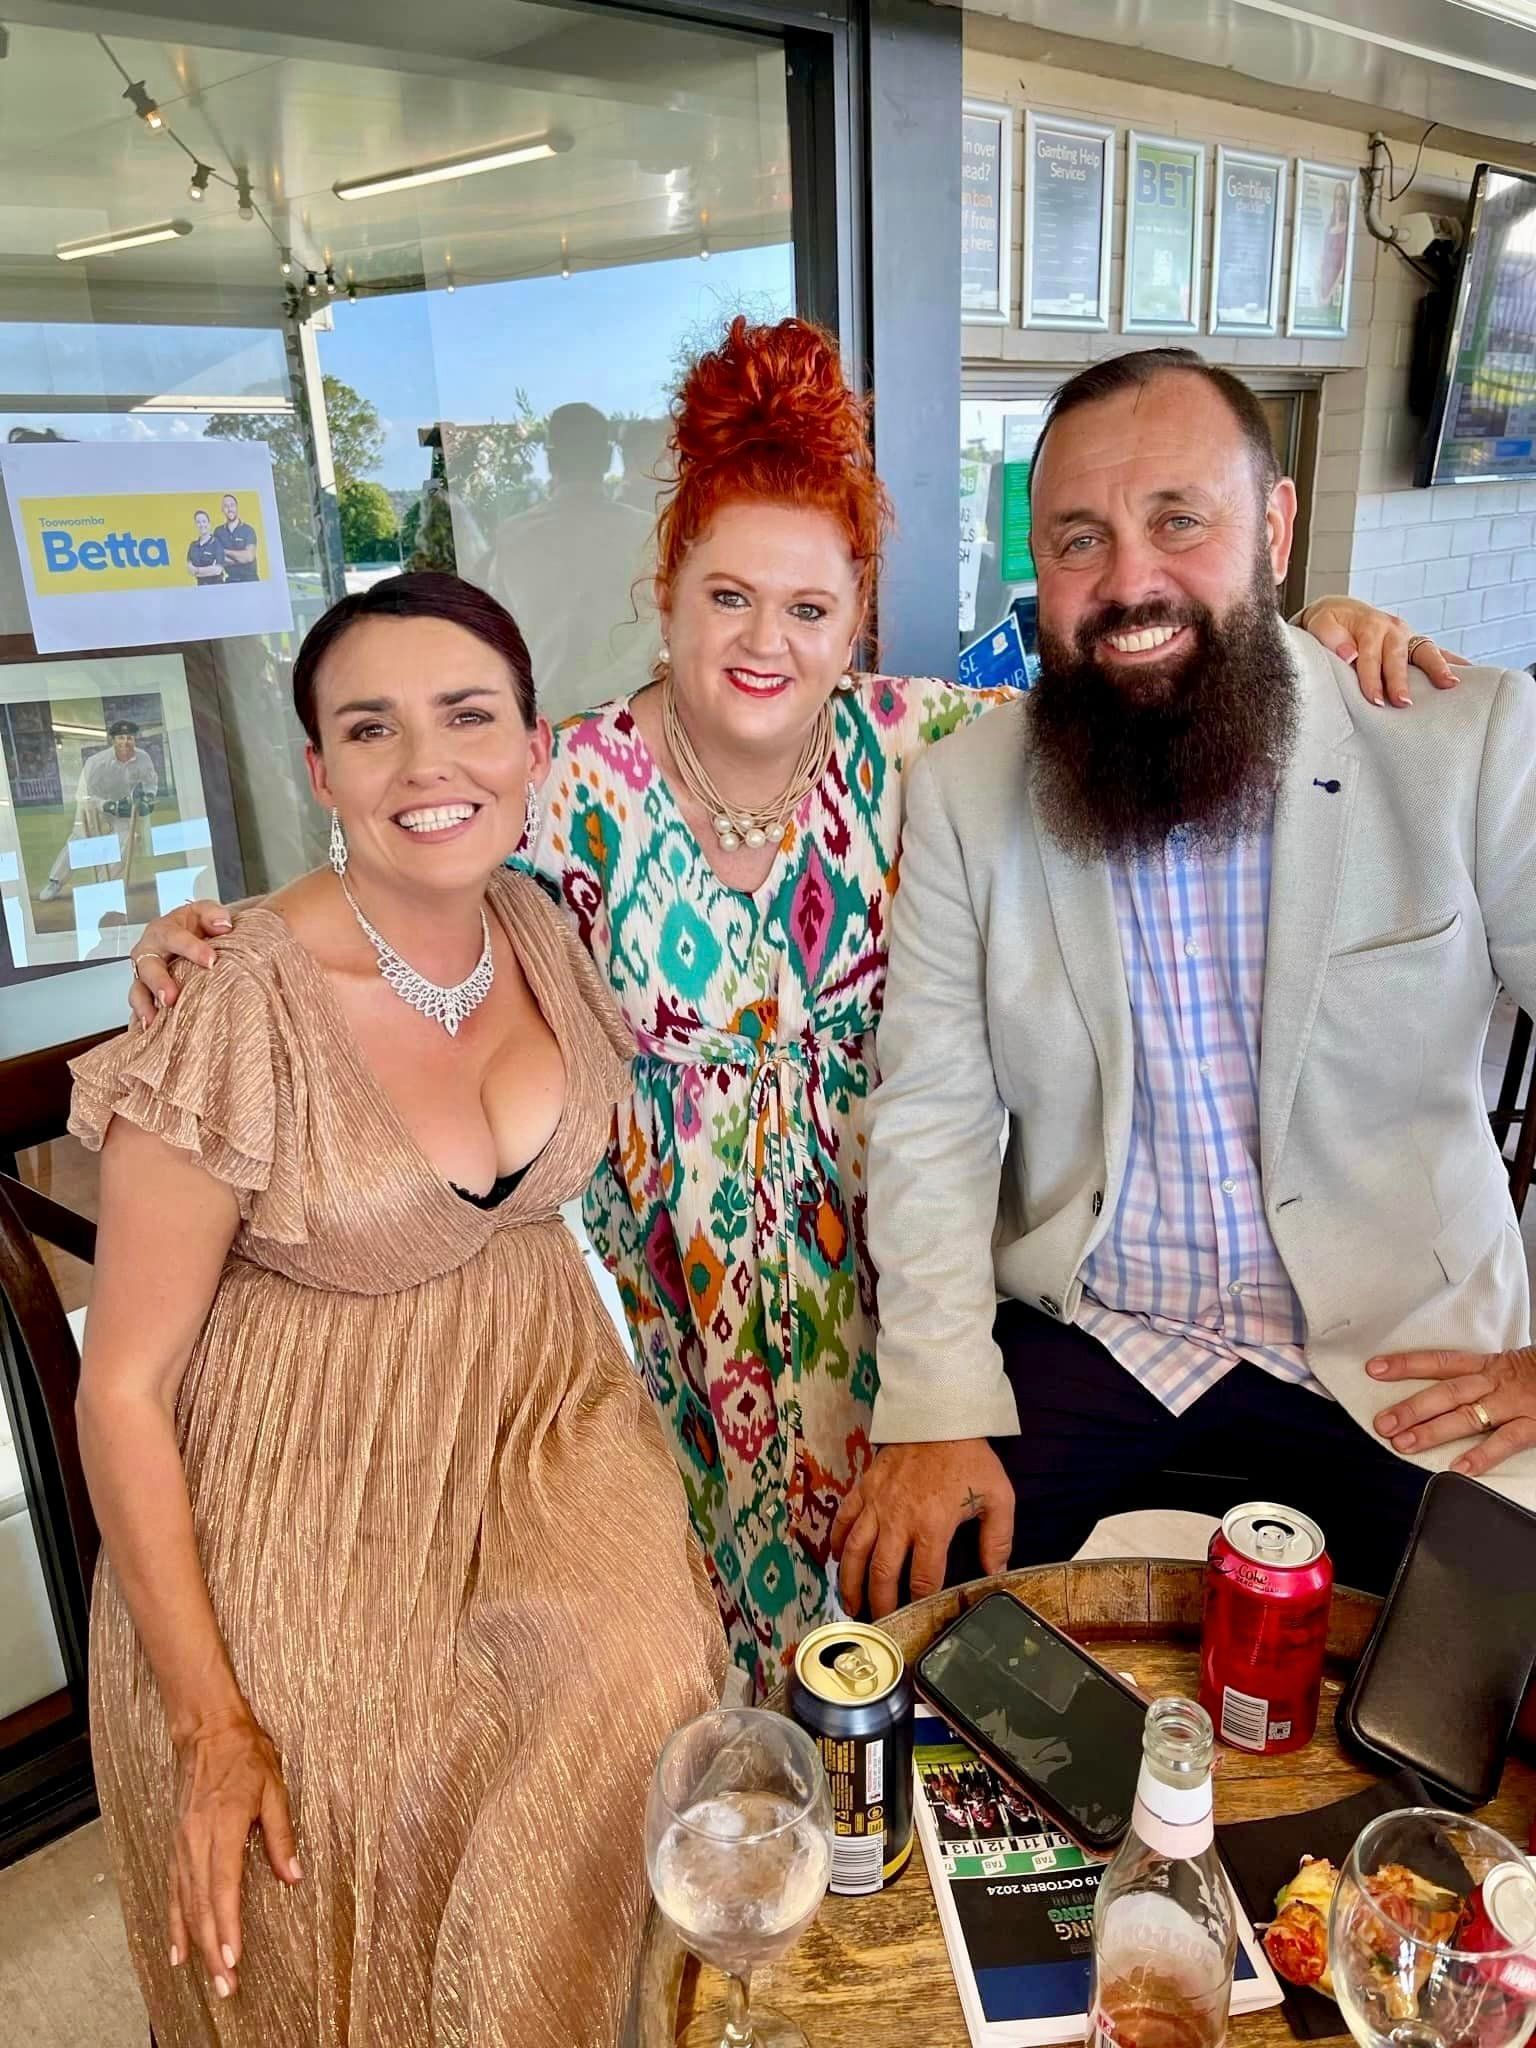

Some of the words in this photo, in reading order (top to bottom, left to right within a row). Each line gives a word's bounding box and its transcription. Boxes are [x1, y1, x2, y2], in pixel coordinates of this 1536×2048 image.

[974, 141, 996, 158] over
[1037, 139, 1078, 165] Gambling
[1079, 147, 1100, 169] Help
[1050, 162, 1087, 181] Services
[1136, 158, 1194, 209] BET
[1226, 174, 1273, 204] Gambling
[971, 210, 996, 230] from
[38, 517, 105, 528] Toowoomba
[41, 531, 170, 573] Betta
[1239, 1563, 1268, 1584] Coke
[951, 1844, 968, 1854] 13
[987, 1841, 1005, 1851] 12
[1024, 1838, 1040, 1849] 11
[984, 1860, 1003, 1870] TAB
[1034, 1856, 1055, 1866] TAB
[1022, 1879, 1083, 1894] OCTOBER
[1085, 1876, 1101, 1886] 19
[986, 1886, 1021, 1896] 2024
